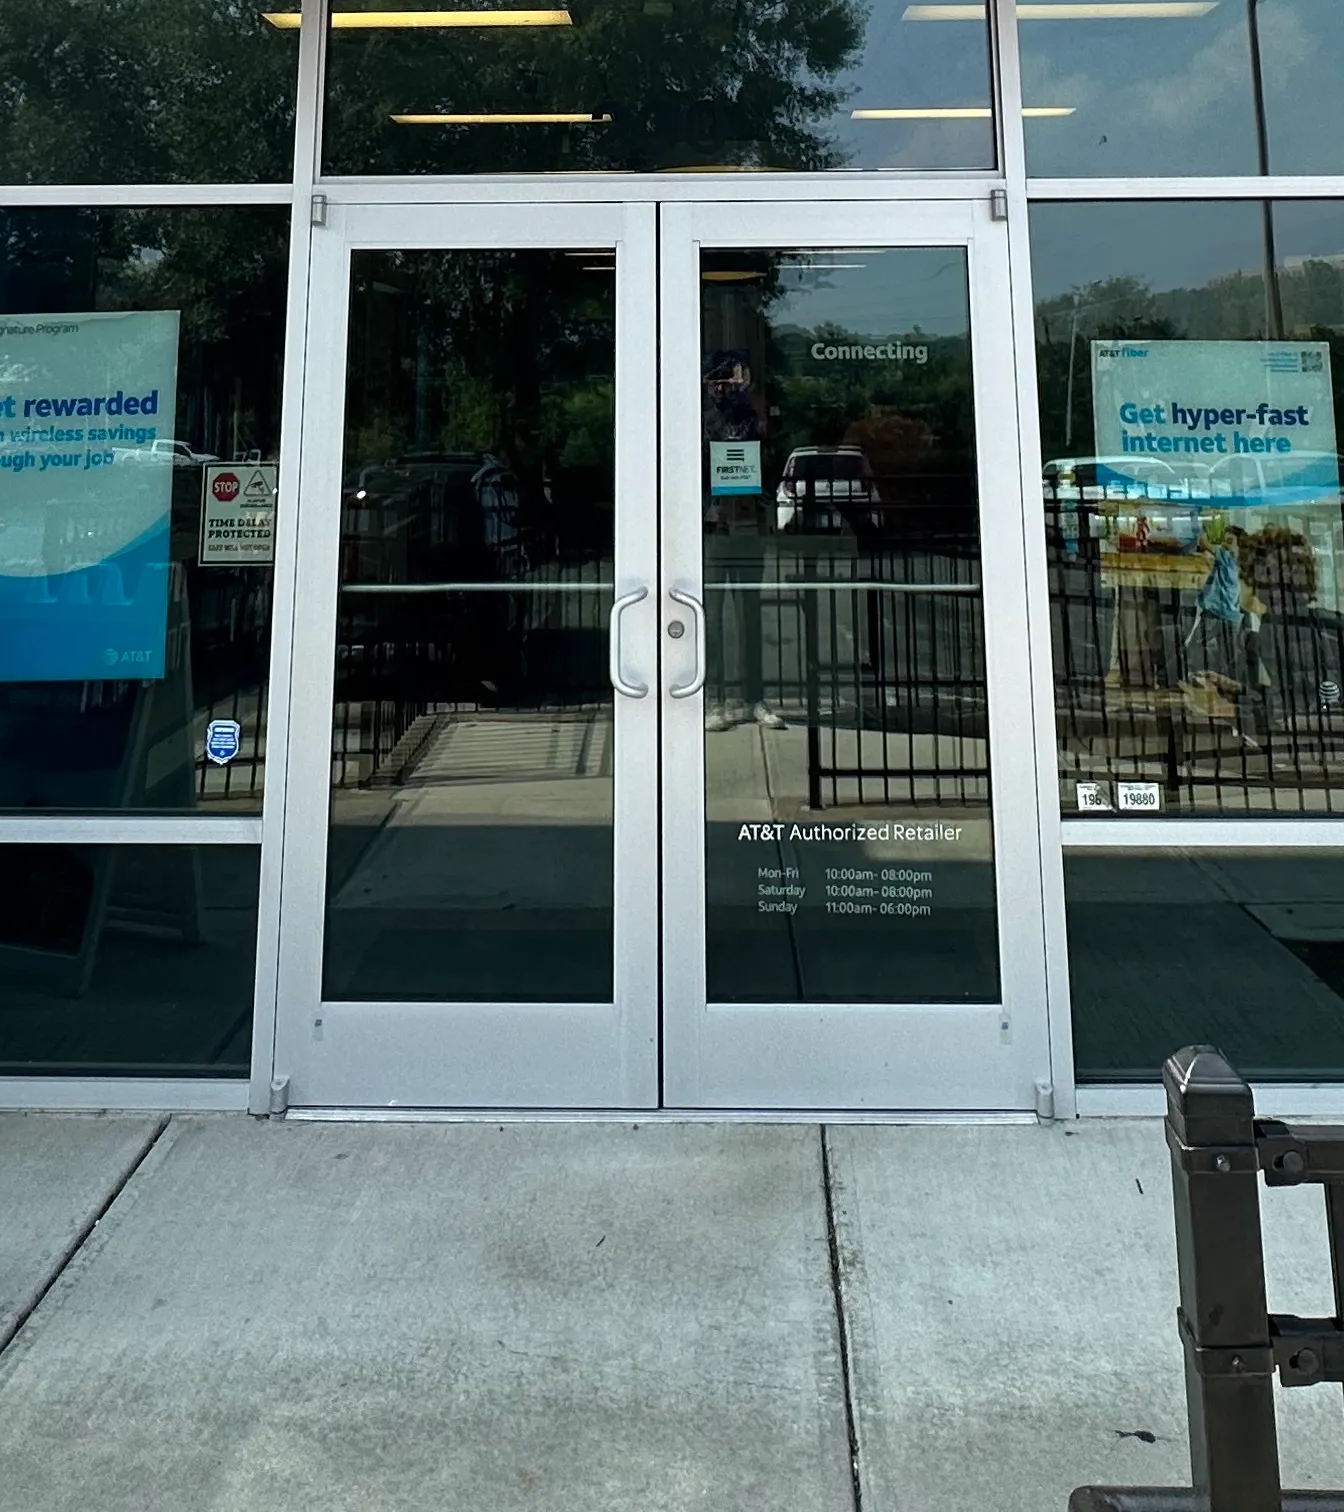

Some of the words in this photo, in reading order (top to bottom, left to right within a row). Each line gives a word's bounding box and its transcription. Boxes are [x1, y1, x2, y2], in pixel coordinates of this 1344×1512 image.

[37, 323, 79, 337] Program
[810, 341, 928, 364] Connecting
[1098, 349, 1121, 358] AT&T
[1122, 348, 1149, 358] fiber
[23, 390, 158, 418] rewarded
[1120, 402, 1165, 424] Get
[1171, 402, 1309, 430] hyper-fast
[9, 425, 84, 443] wireless
[88, 423, 157, 444] savings
[1122, 430, 1228, 453] internet
[1233, 431, 1291, 453] here
[39, 454, 81, 472] your
[84, 449, 114, 470] job
[214, 481, 239, 493] STOP
[208, 518, 235, 528] TIME
[237, 518, 272, 528] DELAY
[208, 529, 272, 539] PROTECTED
[120, 650, 152, 663] AT&T
[1123, 792, 1156, 806] 19880
[737, 824, 785, 841] AT&T
[788, 823, 889, 841] Authorized
[893, 823, 962, 841] Retailer
[757, 867, 799, 879] Mon-Fri
[881, 869, 932, 883] 08:00pm
[757, 884, 806, 898] Saturday
[881, 886, 933, 900] 08:00pm
[757, 900, 798, 915] Sunday
[879, 902, 931, 917] 06:00pm
